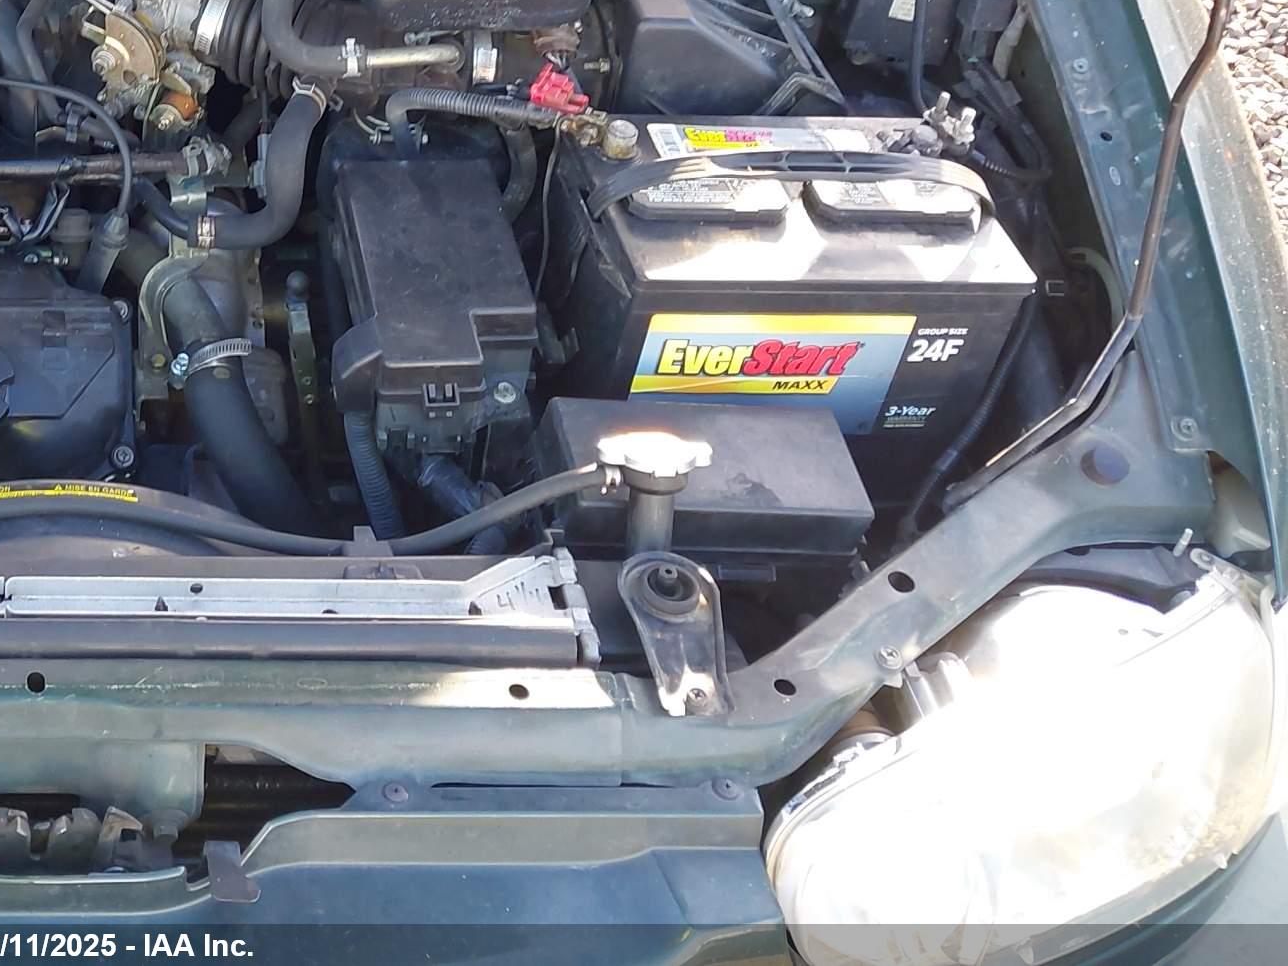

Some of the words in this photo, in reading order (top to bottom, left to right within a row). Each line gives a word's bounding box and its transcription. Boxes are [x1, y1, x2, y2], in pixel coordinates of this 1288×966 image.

[917, 328, 949, 336] GROUP
[906, 338, 965, 362] 24F
[657, 338, 861, 376] EverStart
[772, 380, 829, 390] MAXX
[884, 405, 936, 416] 3-Year
[88, 485, 101, 493] EN
